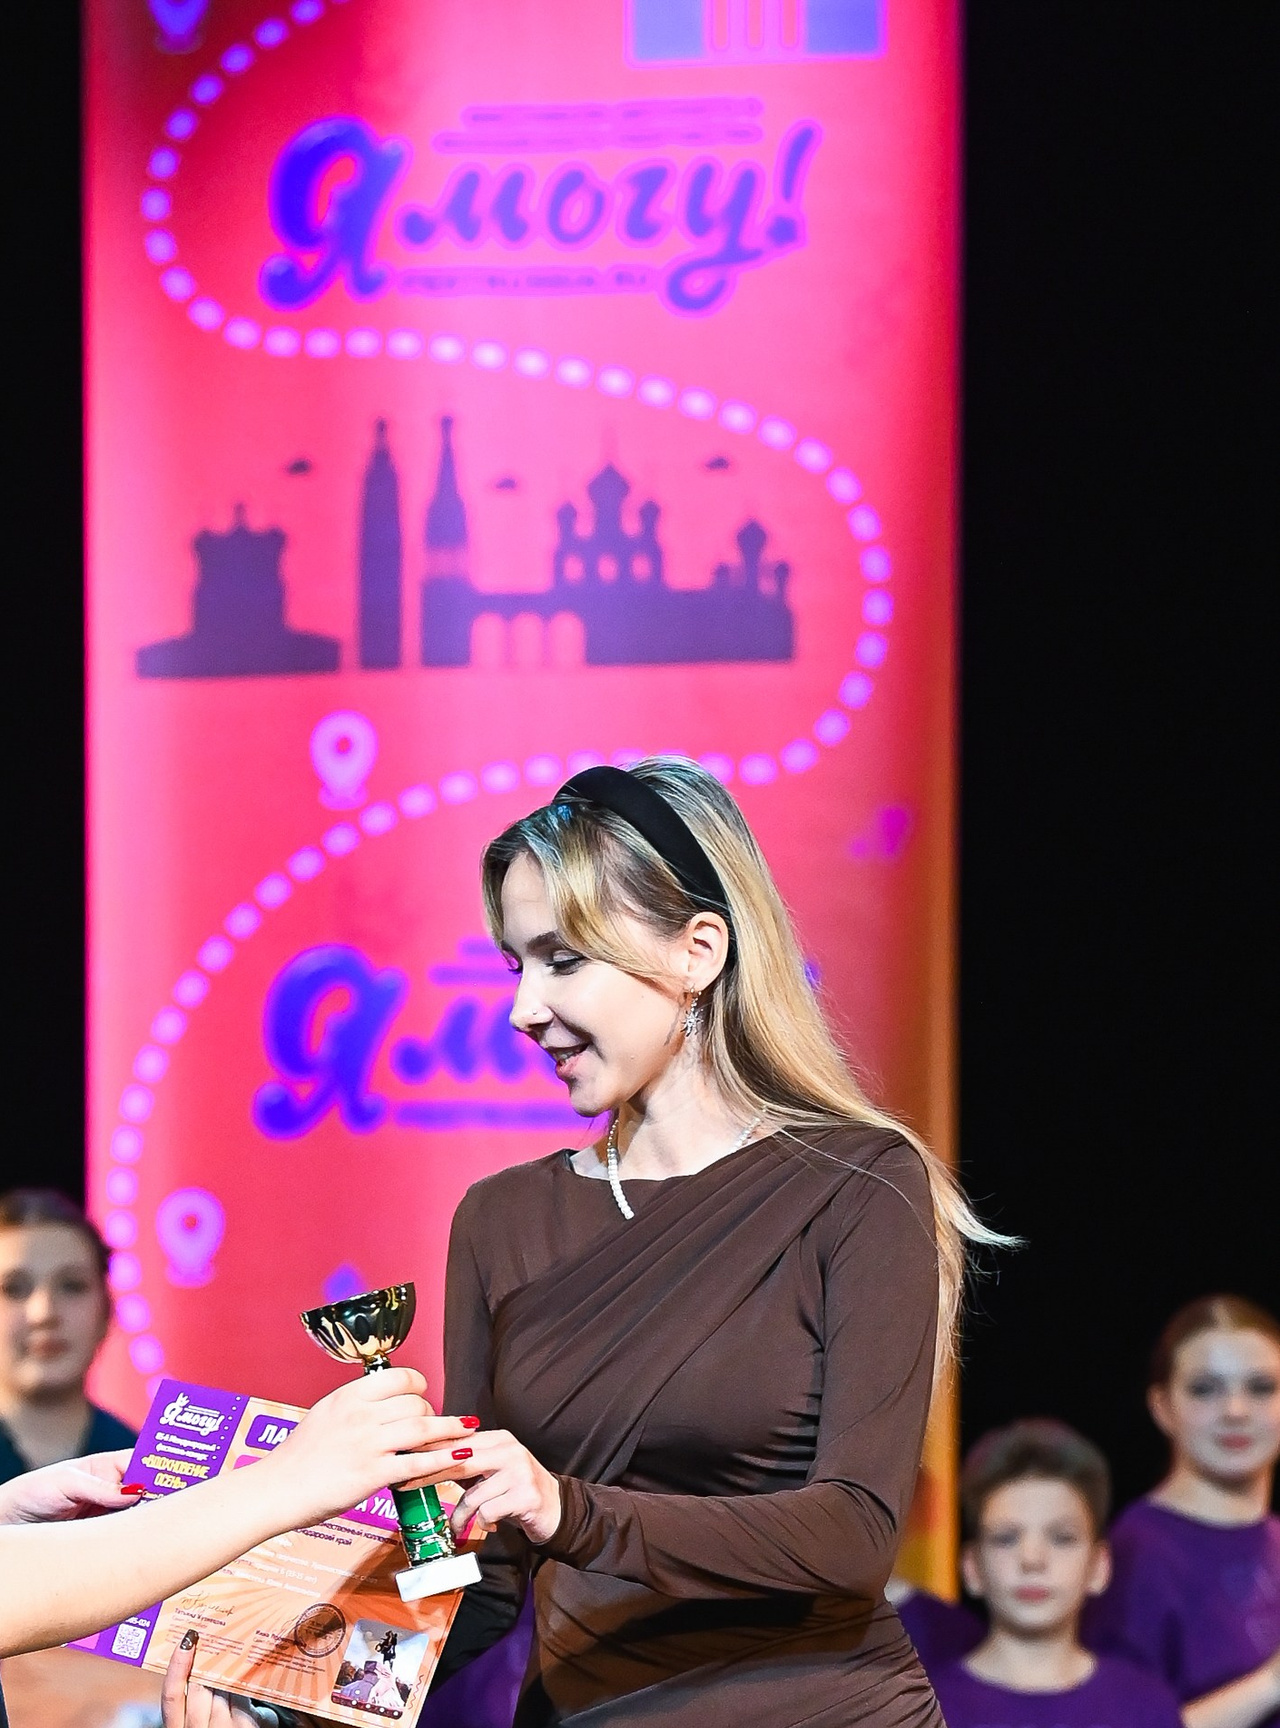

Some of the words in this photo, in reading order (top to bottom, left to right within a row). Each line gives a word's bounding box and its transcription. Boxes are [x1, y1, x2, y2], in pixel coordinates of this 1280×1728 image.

[261, 116, 410, 308] Я
[398, 120, 820, 314] могу!
[258, 1423, 295, 1446] ЛА
[371, 1496, 401, 1520] УЛЬ
